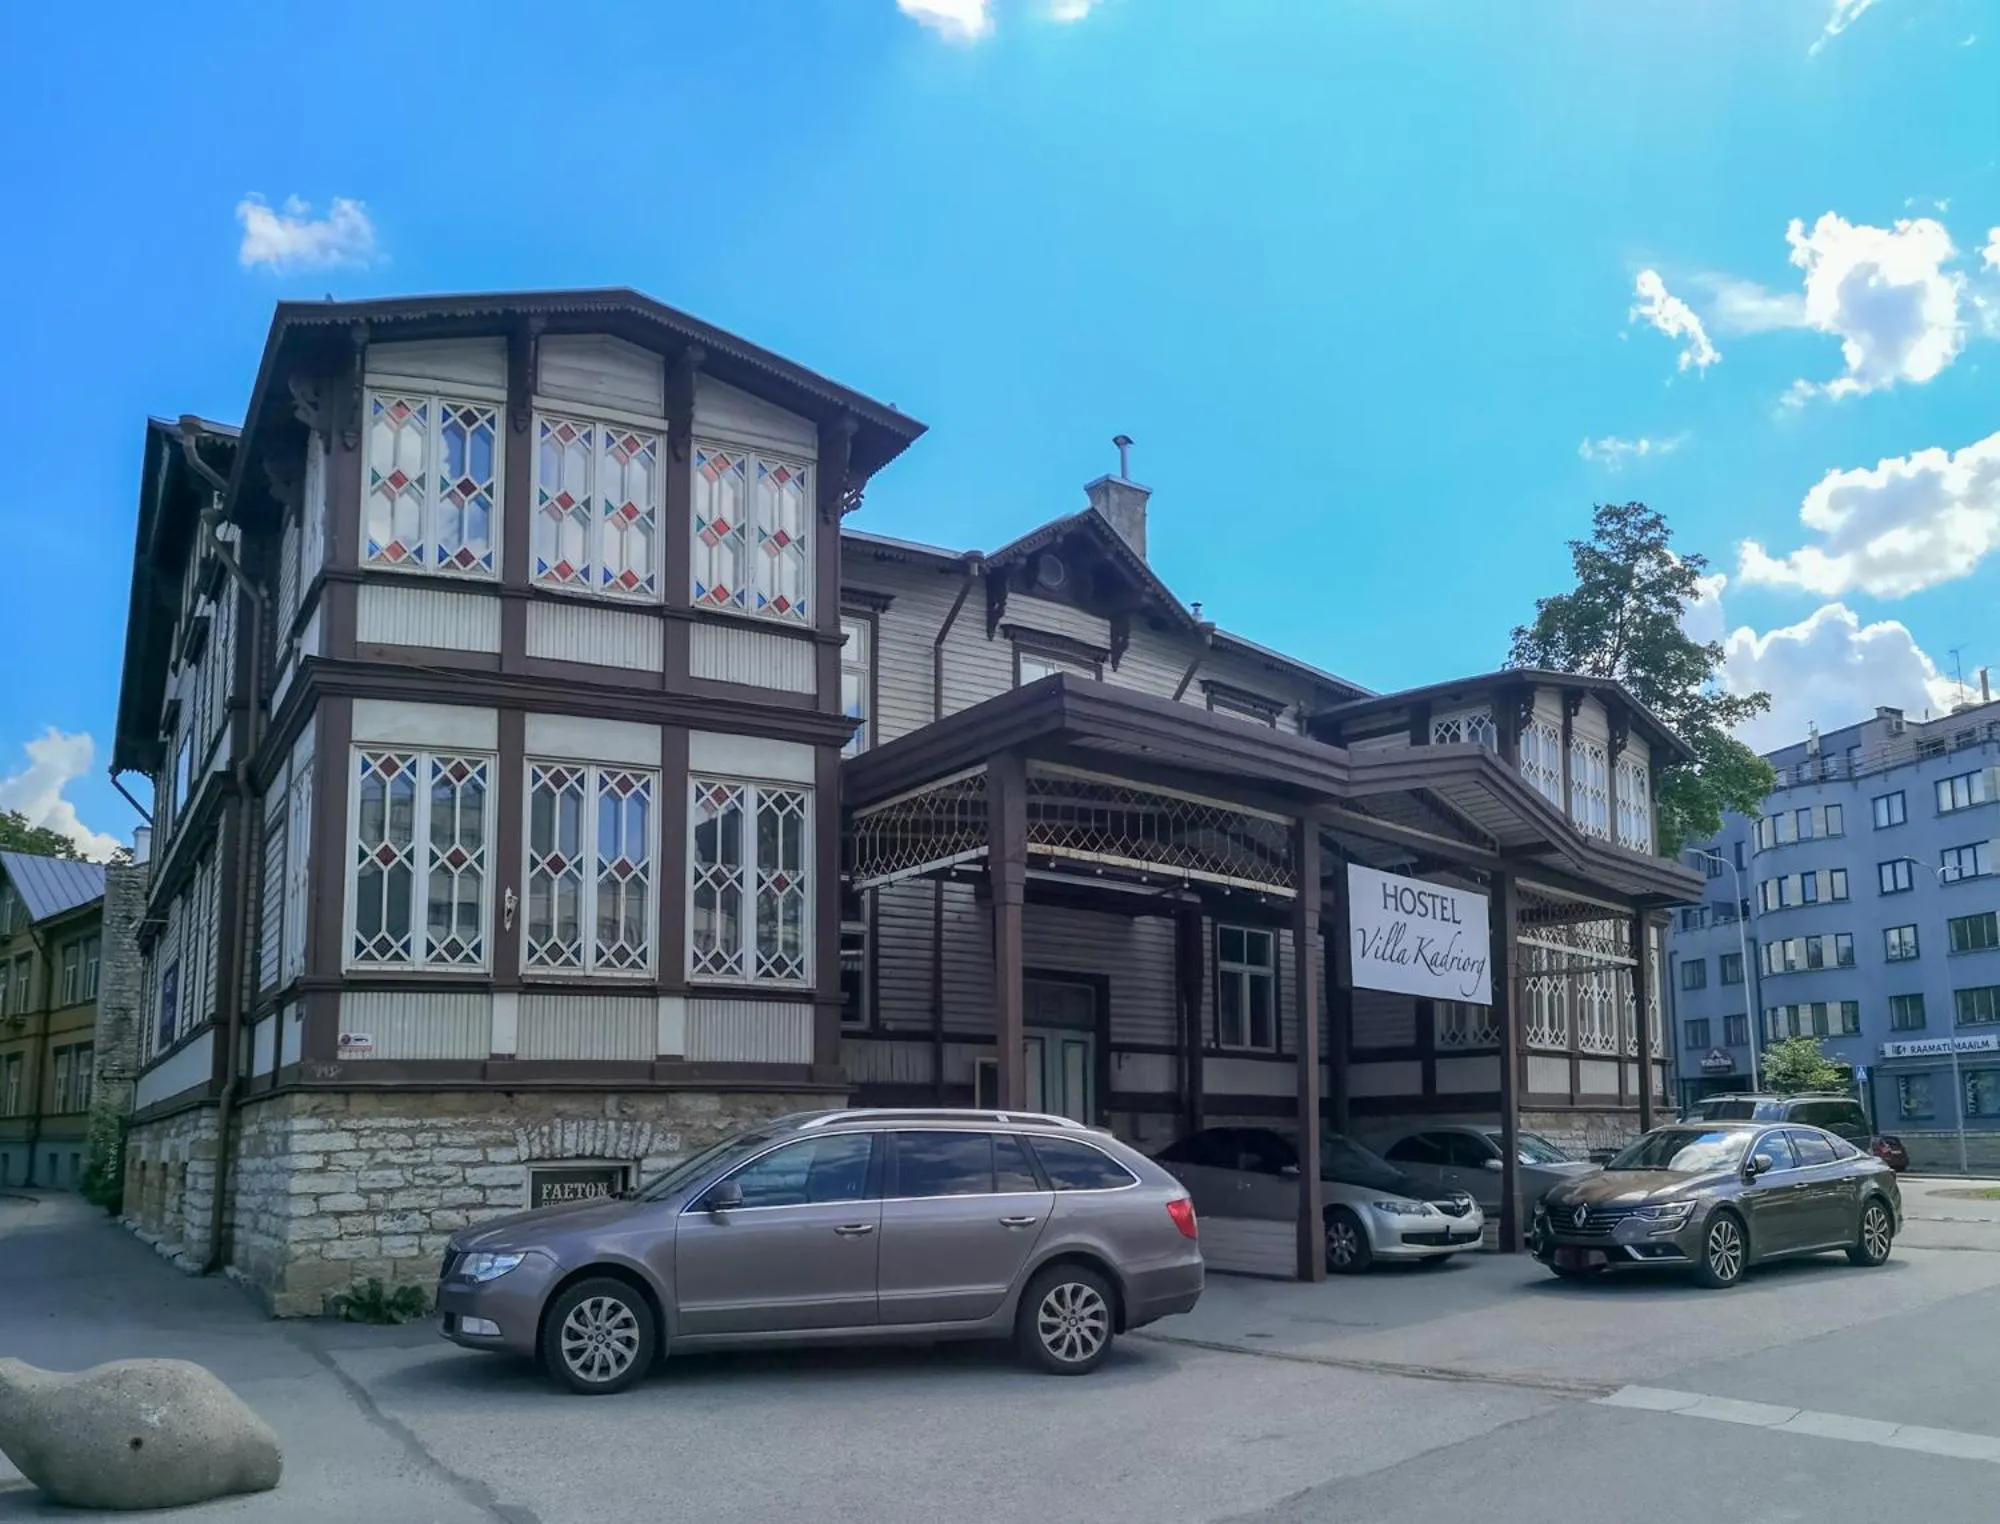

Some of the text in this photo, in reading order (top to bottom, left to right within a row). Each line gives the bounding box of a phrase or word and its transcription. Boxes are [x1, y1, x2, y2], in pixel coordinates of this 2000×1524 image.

[1382, 882, 1462, 925] HOSTEL
[1356, 920, 1487, 998] Villa Kadriorg
[541, 1182, 609, 1200] FAETON
